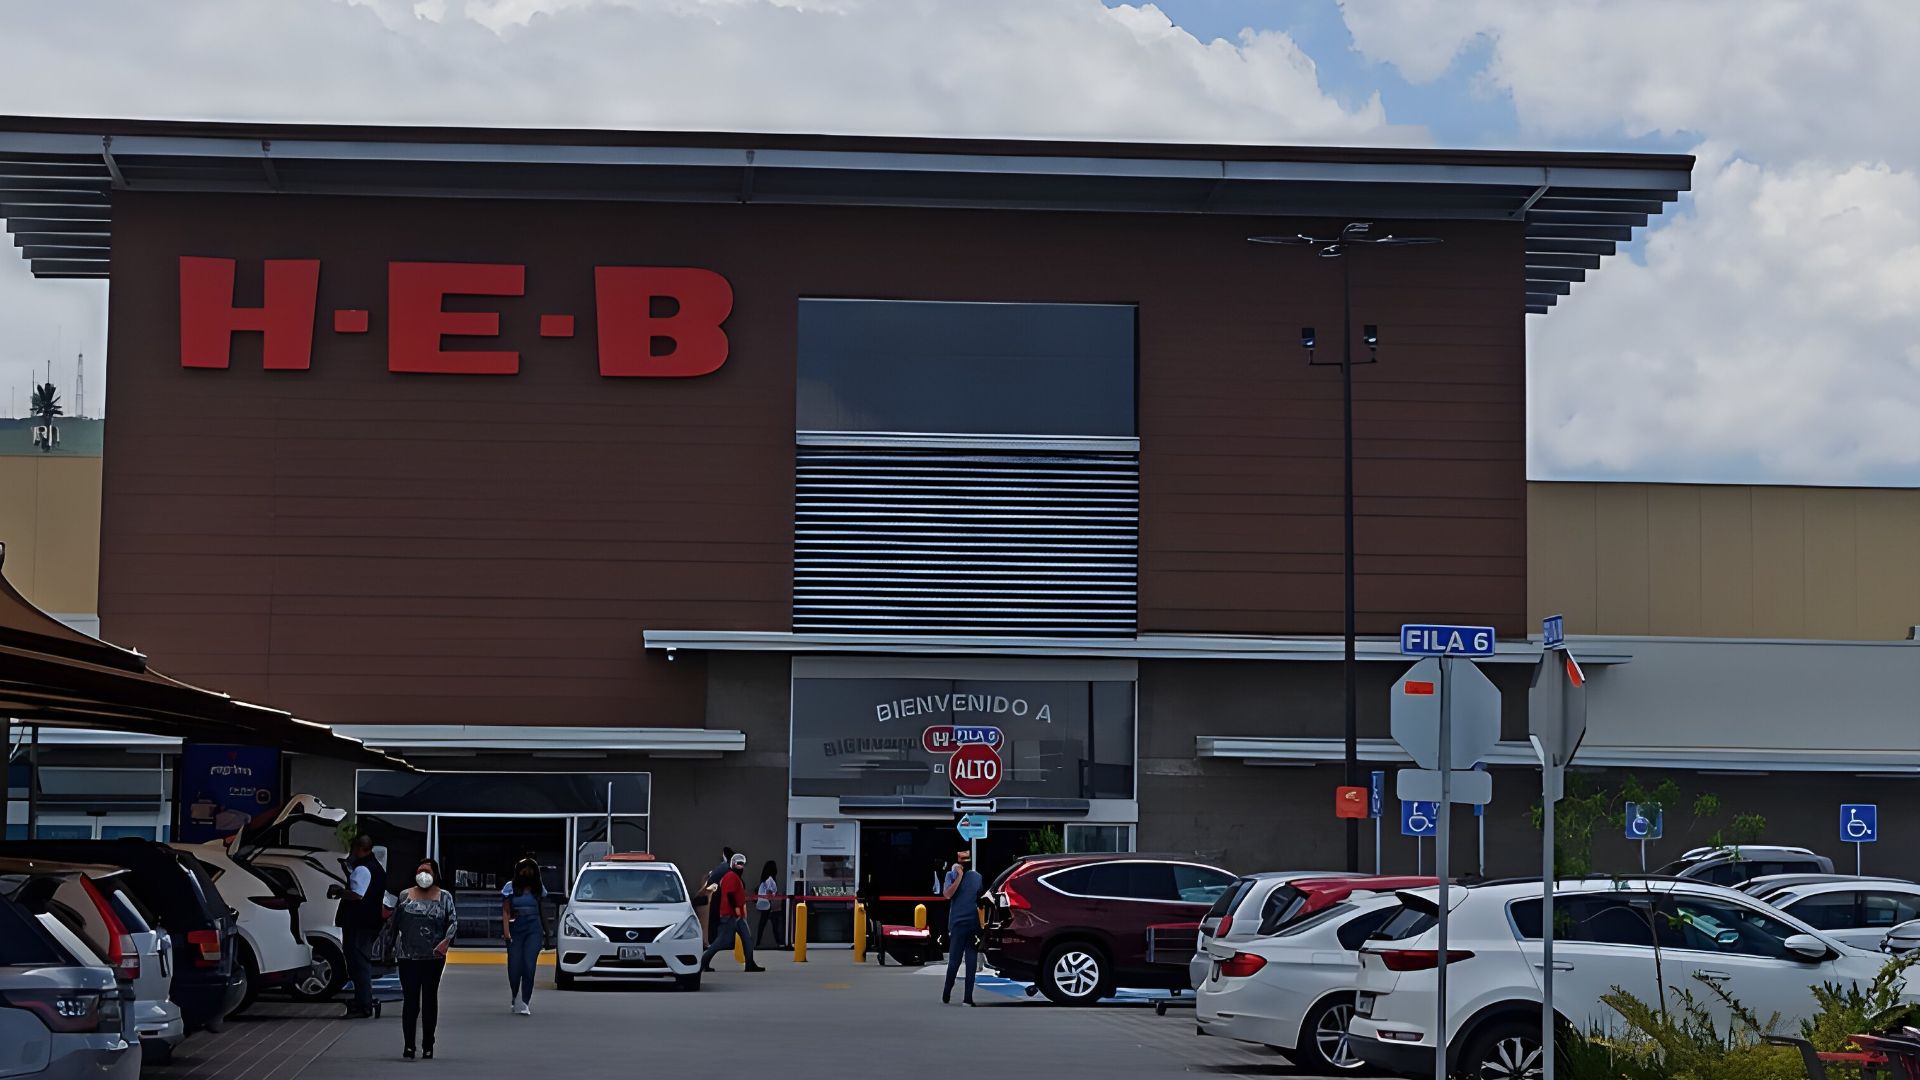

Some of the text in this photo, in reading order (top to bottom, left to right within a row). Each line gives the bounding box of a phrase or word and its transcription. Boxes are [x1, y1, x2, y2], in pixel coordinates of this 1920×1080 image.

[179, 255, 734, 377] H-E-B
[1405, 630, 1489, 651] FILA 6
[876, 694, 1051, 723] BIENVENIDO A
[955, 758, 997, 780] ALTO
